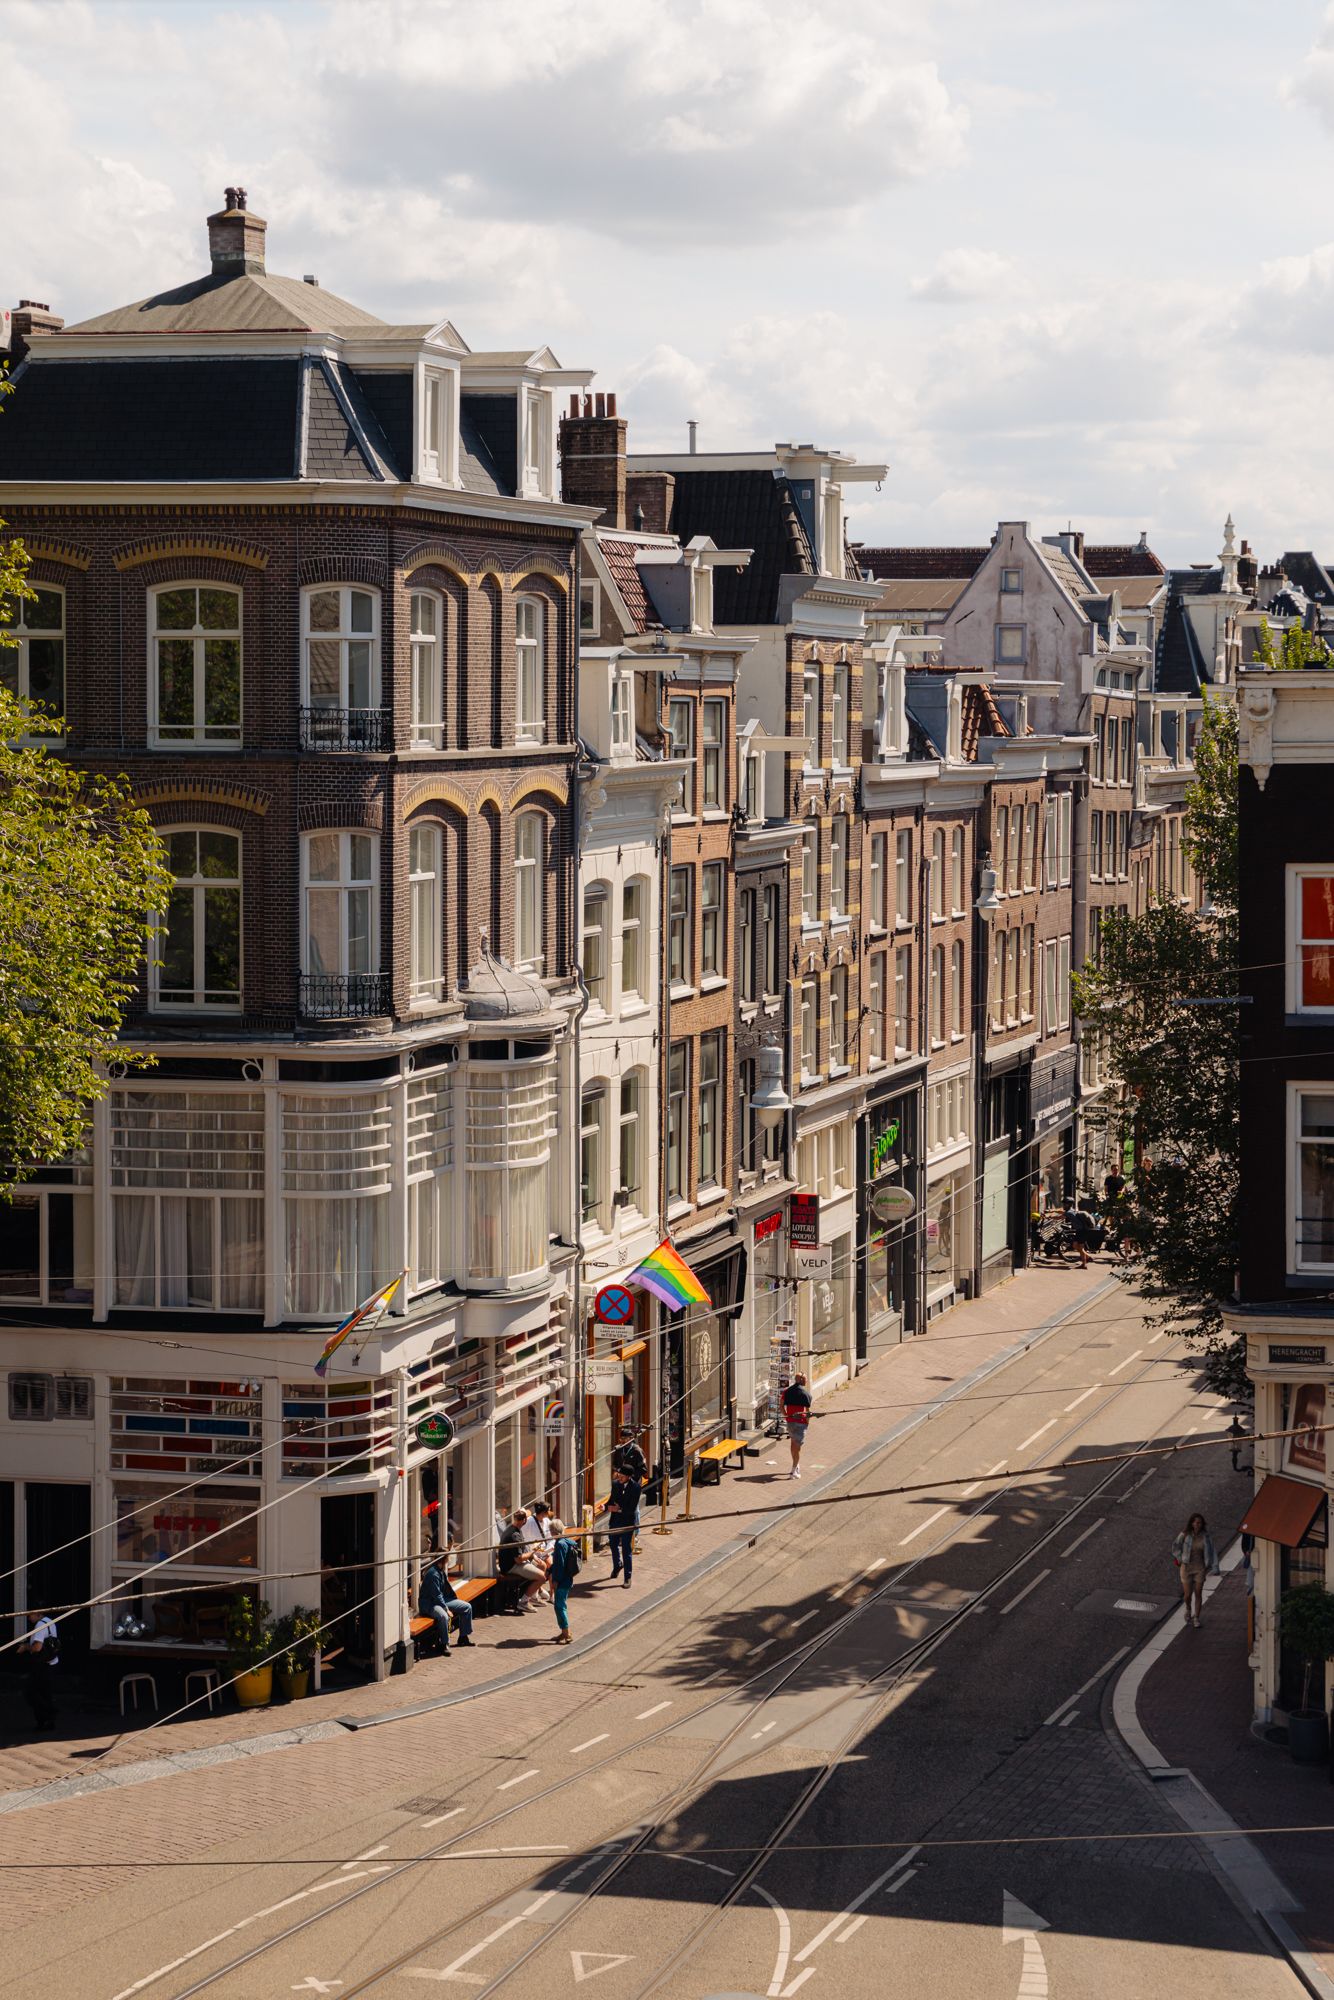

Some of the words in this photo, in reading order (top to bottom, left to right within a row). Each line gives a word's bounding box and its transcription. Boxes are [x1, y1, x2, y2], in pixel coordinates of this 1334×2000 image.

[791, 1224, 816, 1234] LOTERIJ
[801, 1258, 828, 1268] VELD
[1271, 1347, 1322, 1357] HERENGRACHT
